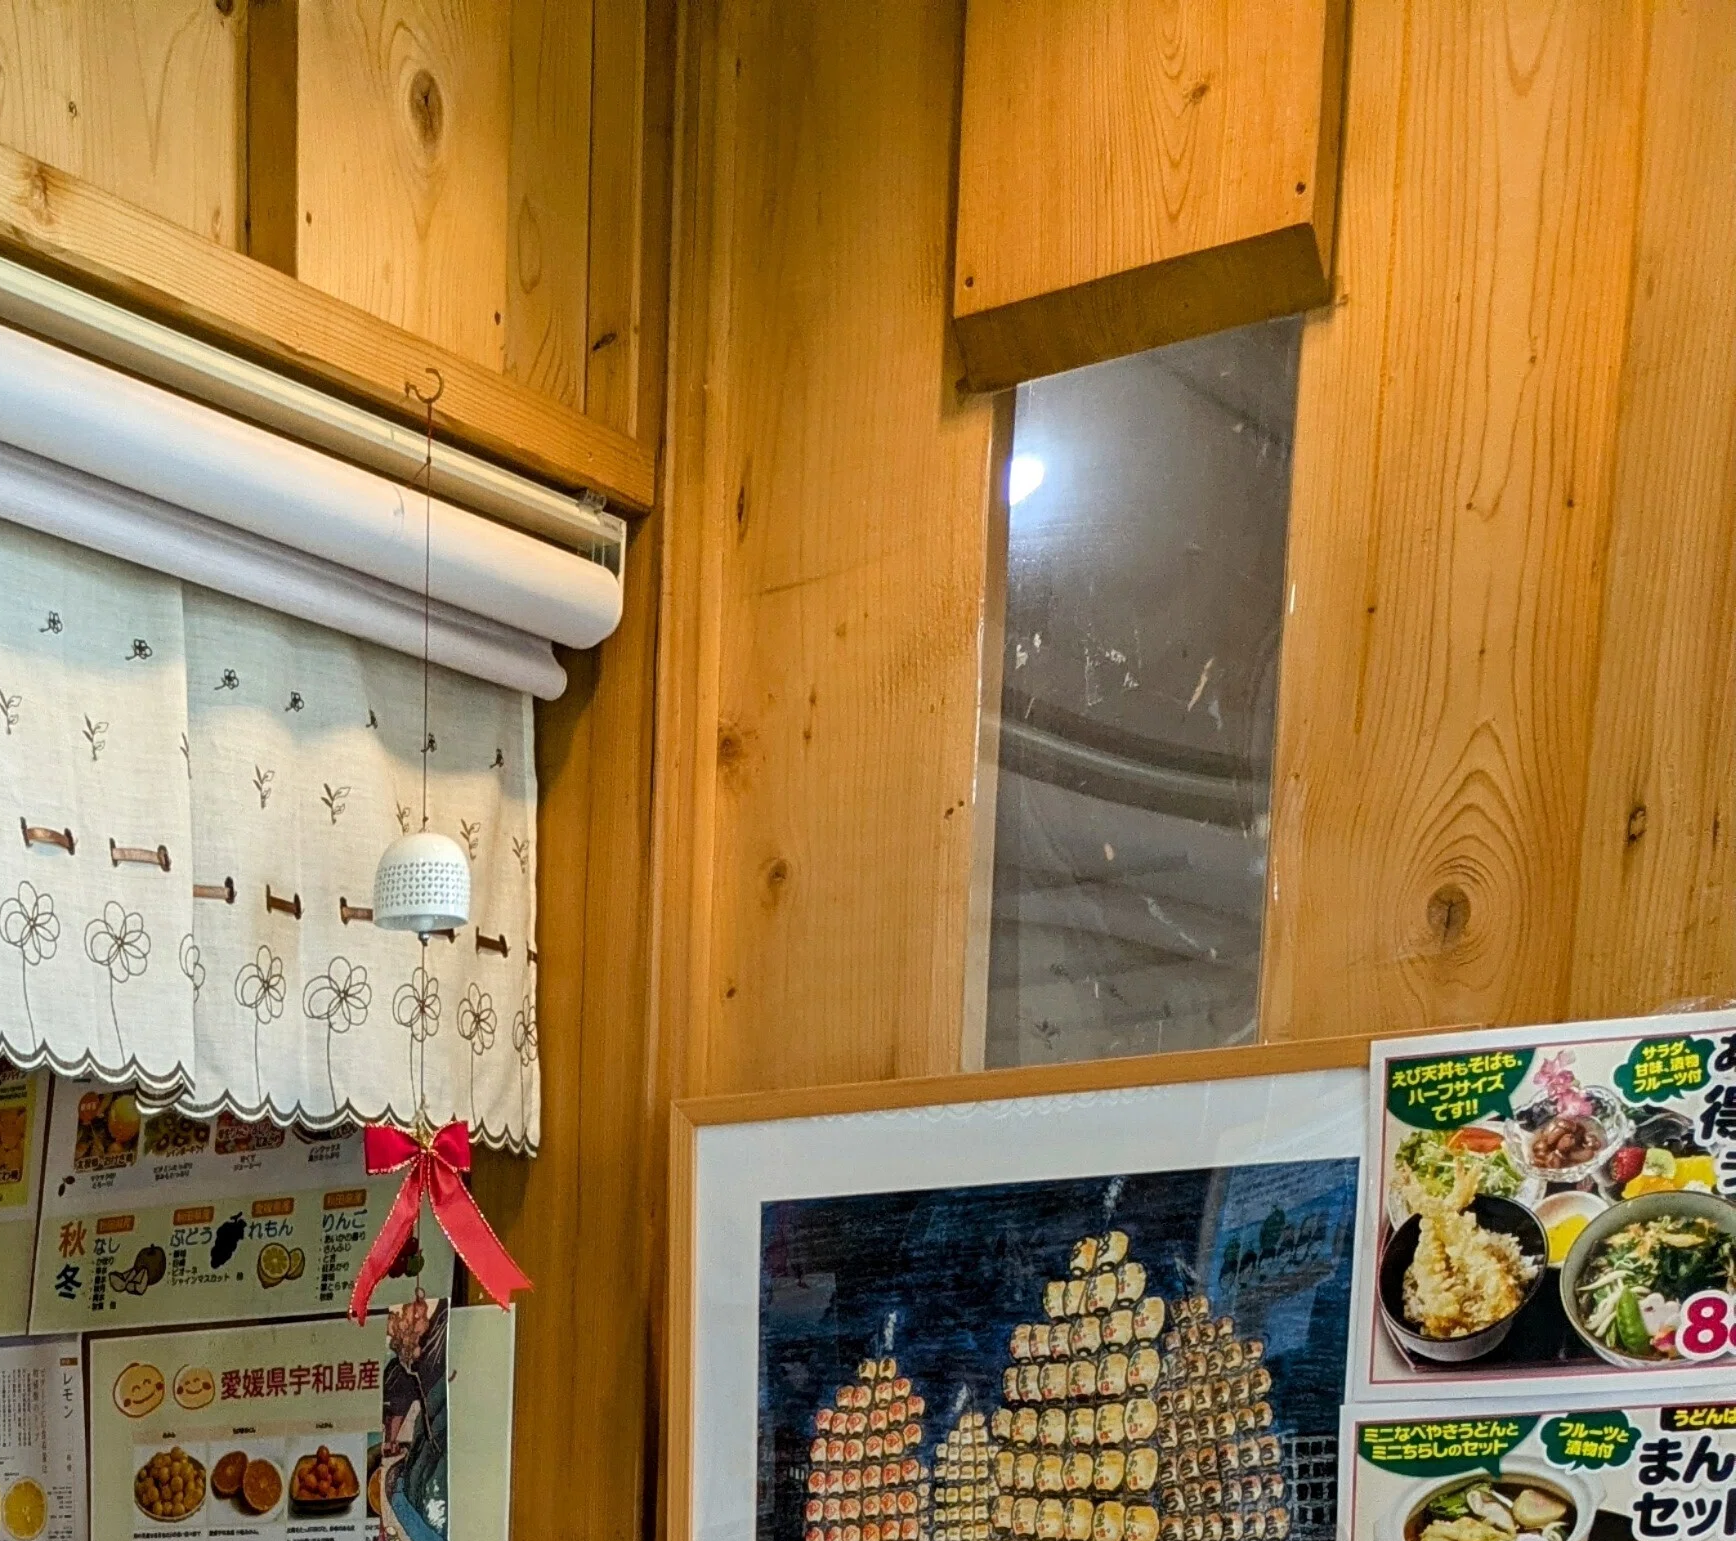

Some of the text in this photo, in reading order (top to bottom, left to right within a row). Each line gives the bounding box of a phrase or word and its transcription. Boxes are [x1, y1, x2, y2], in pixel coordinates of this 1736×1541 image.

[1409, 1076, 1505, 1104] ハーフサイズ
[1633, 1069, 1702, 1093] フルーツ付
[170, 1226, 212, 1247] ぶどう
[250, 1218, 294, 1237] れもん
[94, 1237, 120, 1255] なし
[220, 1360, 381, 1401] 愛媛県宇和島産
[62, 1373, 74, 1420] レモン
[1364, 1423, 1519, 1443] ミニなべやきうどんと
[1558, 1422, 1629, 1443] フルーツと
[1372, 1442, 1508, 1461] ミニちらしのセット
